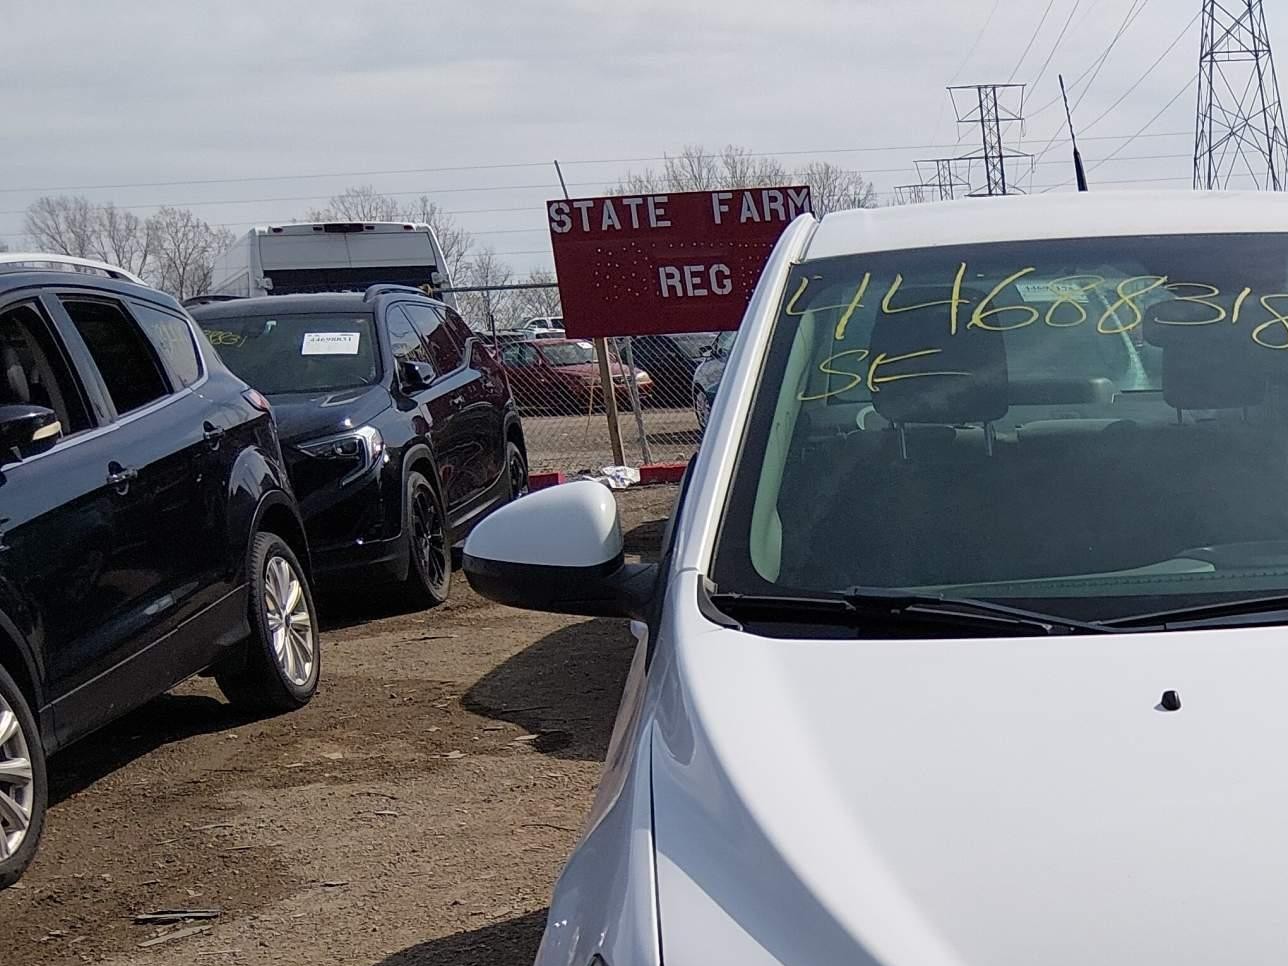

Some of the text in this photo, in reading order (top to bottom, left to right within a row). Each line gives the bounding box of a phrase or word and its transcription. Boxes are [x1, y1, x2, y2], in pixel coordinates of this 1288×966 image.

[549, 188, 810, 233] STATE FARM
[658, 263, 733, 298] REG
